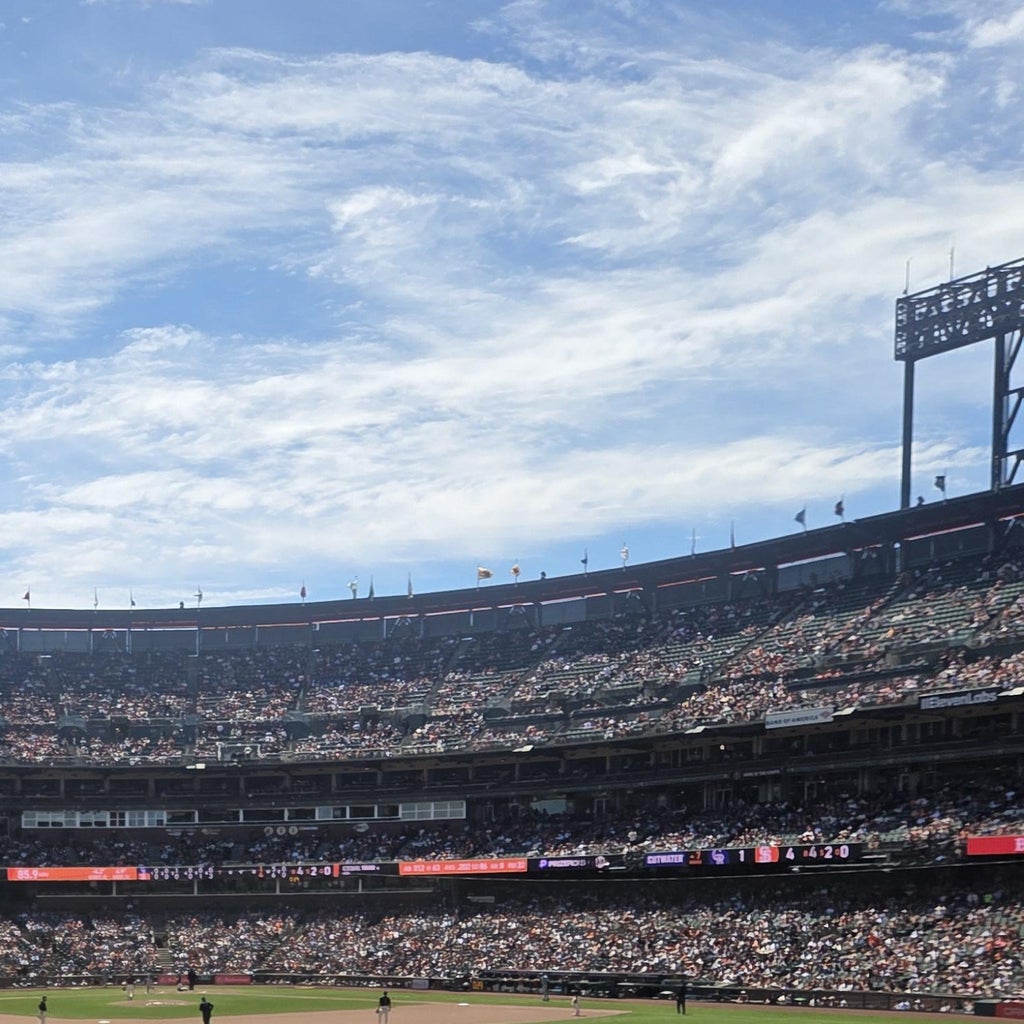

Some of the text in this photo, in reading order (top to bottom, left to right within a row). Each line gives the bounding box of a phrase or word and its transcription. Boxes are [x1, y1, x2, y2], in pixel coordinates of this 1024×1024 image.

[738, 850, 745, 862] 1
[785, 847, 795, 860] 4
[824, 845, 833, 859] 2
[840, 845, 849, 858] 0
[17, 869, 39, 880] 85.9
[296, 866, 304, 875] 4
[310, 866, 318, 876] 2
[324, 866, 331, 876] 0
